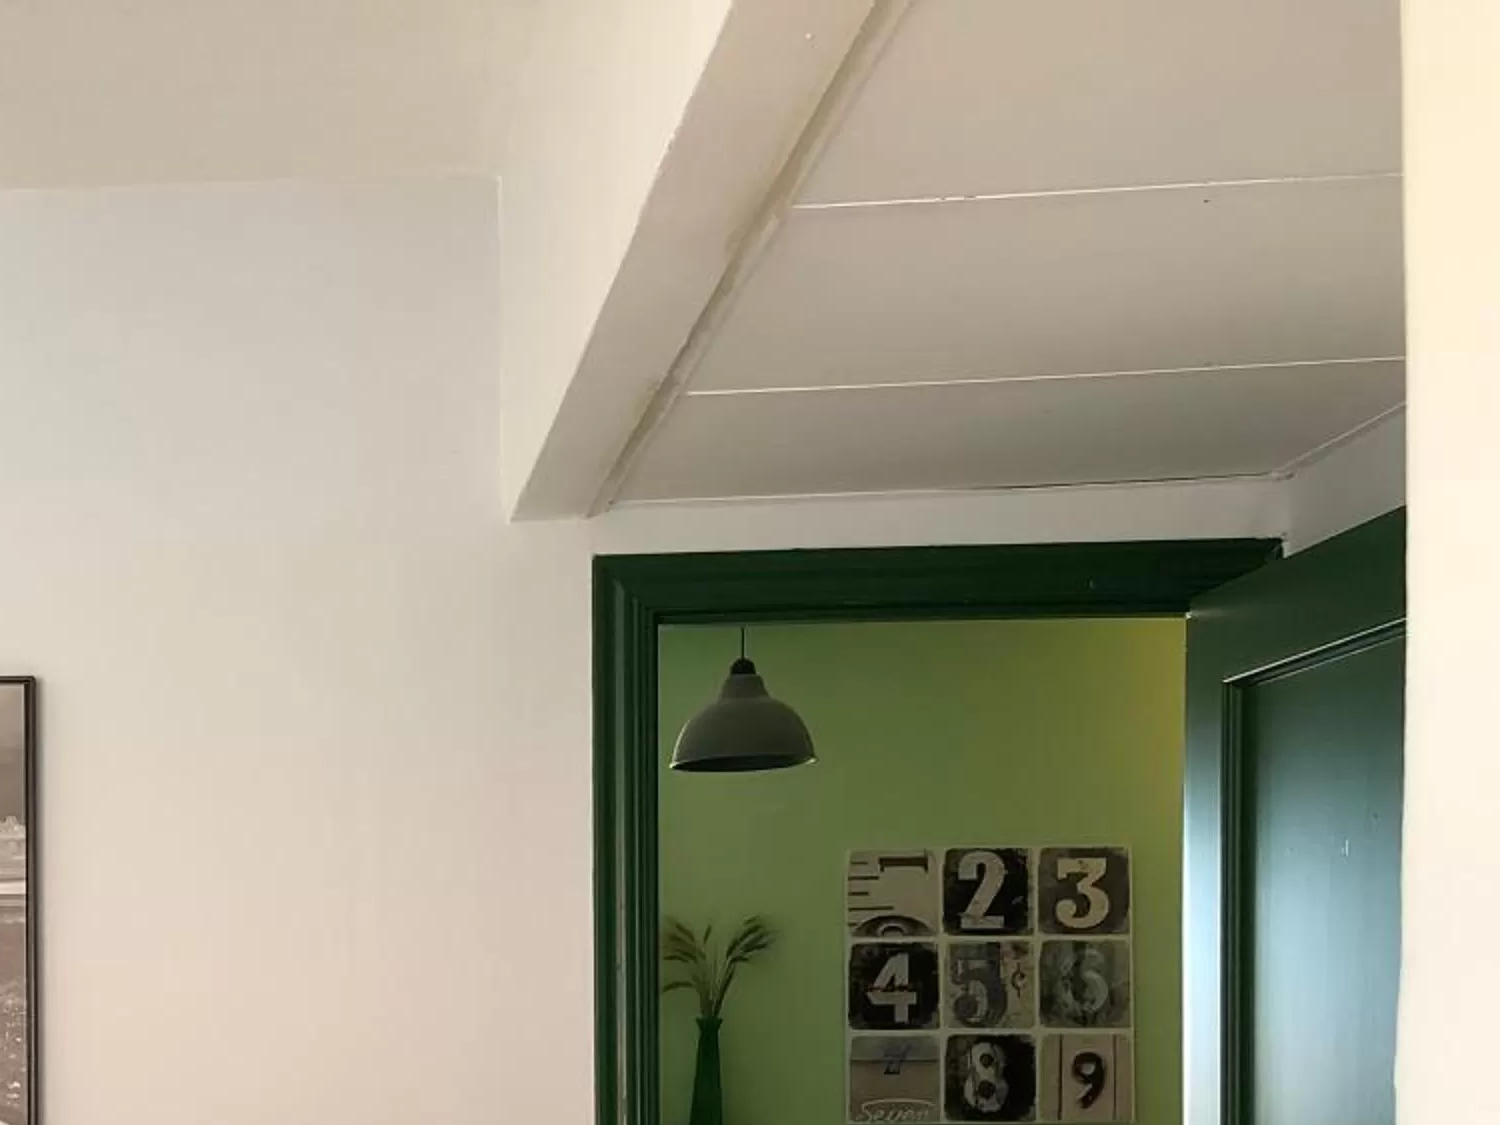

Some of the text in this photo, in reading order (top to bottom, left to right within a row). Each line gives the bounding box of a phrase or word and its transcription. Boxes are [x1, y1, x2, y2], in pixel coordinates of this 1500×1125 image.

[957, 850, 1005, 930] 2
[1055, 856, 1110, 929] 3
[866, 952, 917, 1024] 4
[1057, 947, 1109, 1015] 6
[963, 1041, 1009, 1113] 8
[1071, 1050, 1108, 1109] 9
